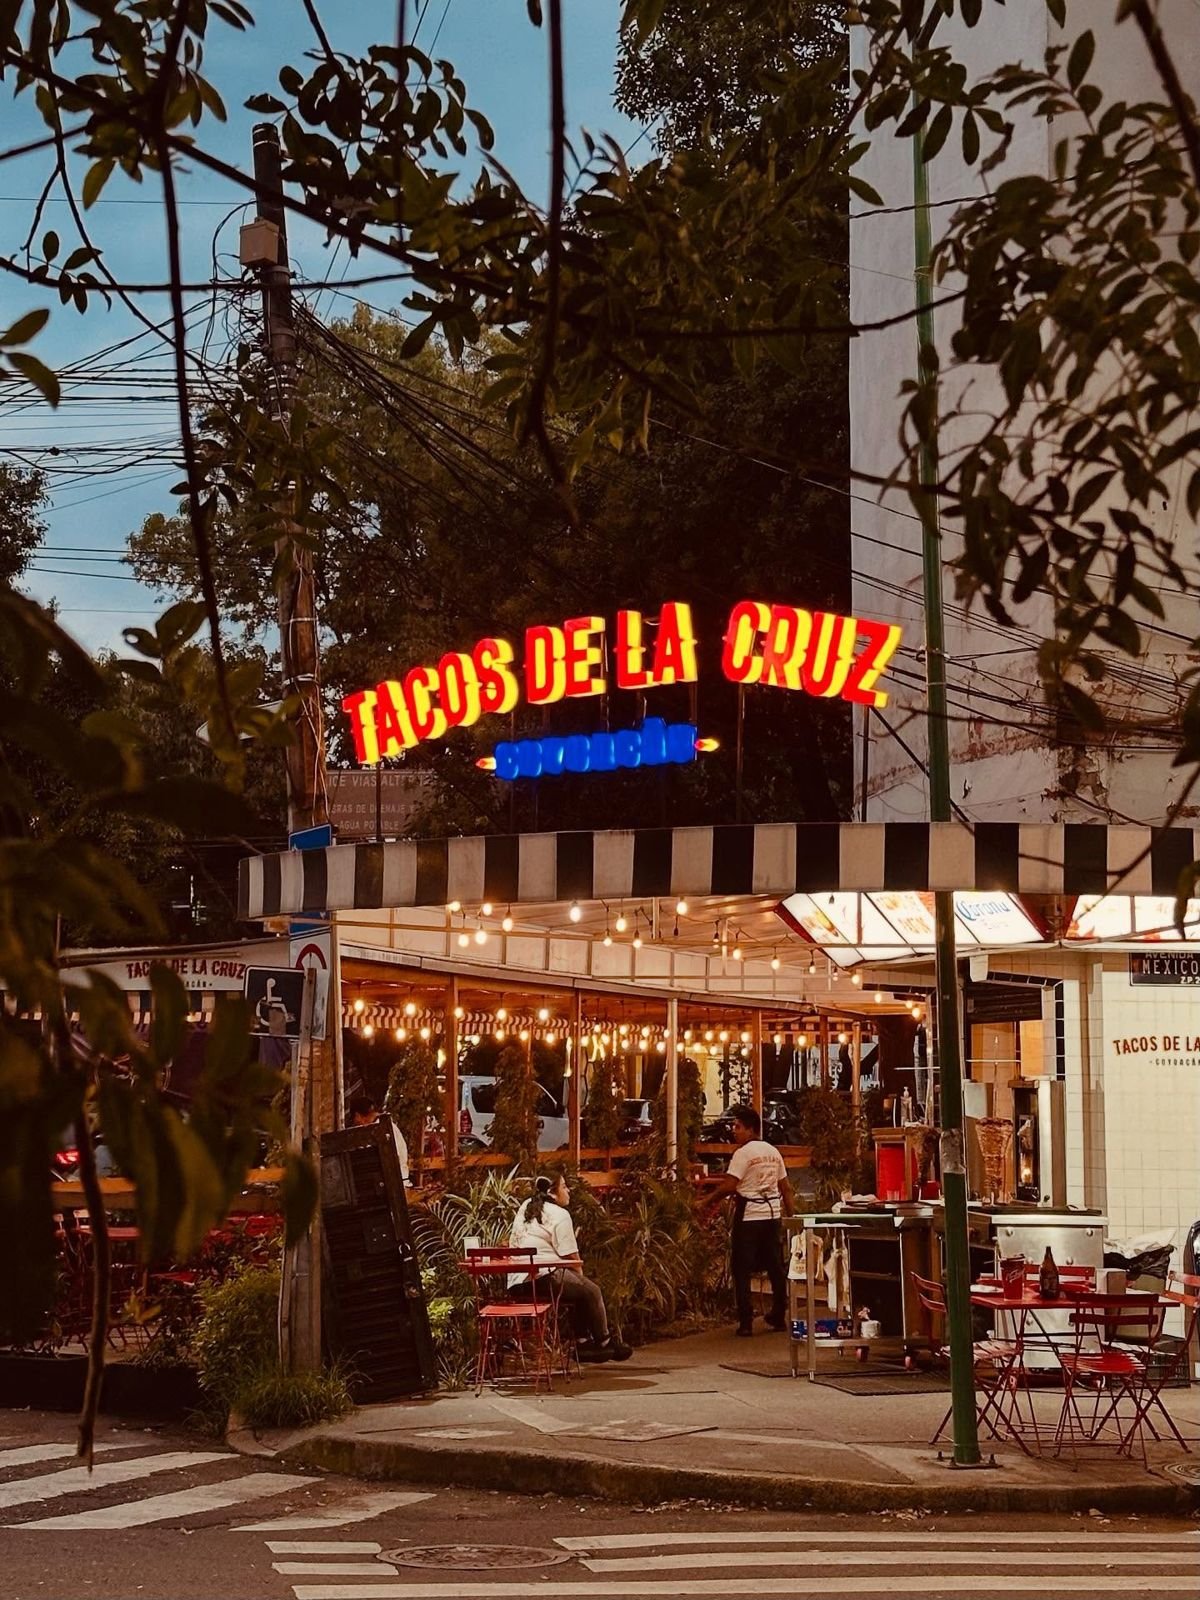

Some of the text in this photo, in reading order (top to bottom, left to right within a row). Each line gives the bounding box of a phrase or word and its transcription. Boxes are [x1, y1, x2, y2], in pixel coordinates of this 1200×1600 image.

[342, 638, 519, 765] TACOS
[523, 616, 606, 705] DE
[616, 601, 698, 689] LA
[721, 601, 902, 708] CRUZ
[369, 804, 406, 814] DENAJE
[192, 959, 208, 975] LA
[211, 960, 246, 980] CRUZ
[1142, 959, 1199, 975] MEXICO
[1112, 1035, 1158, 1055] TACOS
[1163, 1035, 1181, 1051] DE
